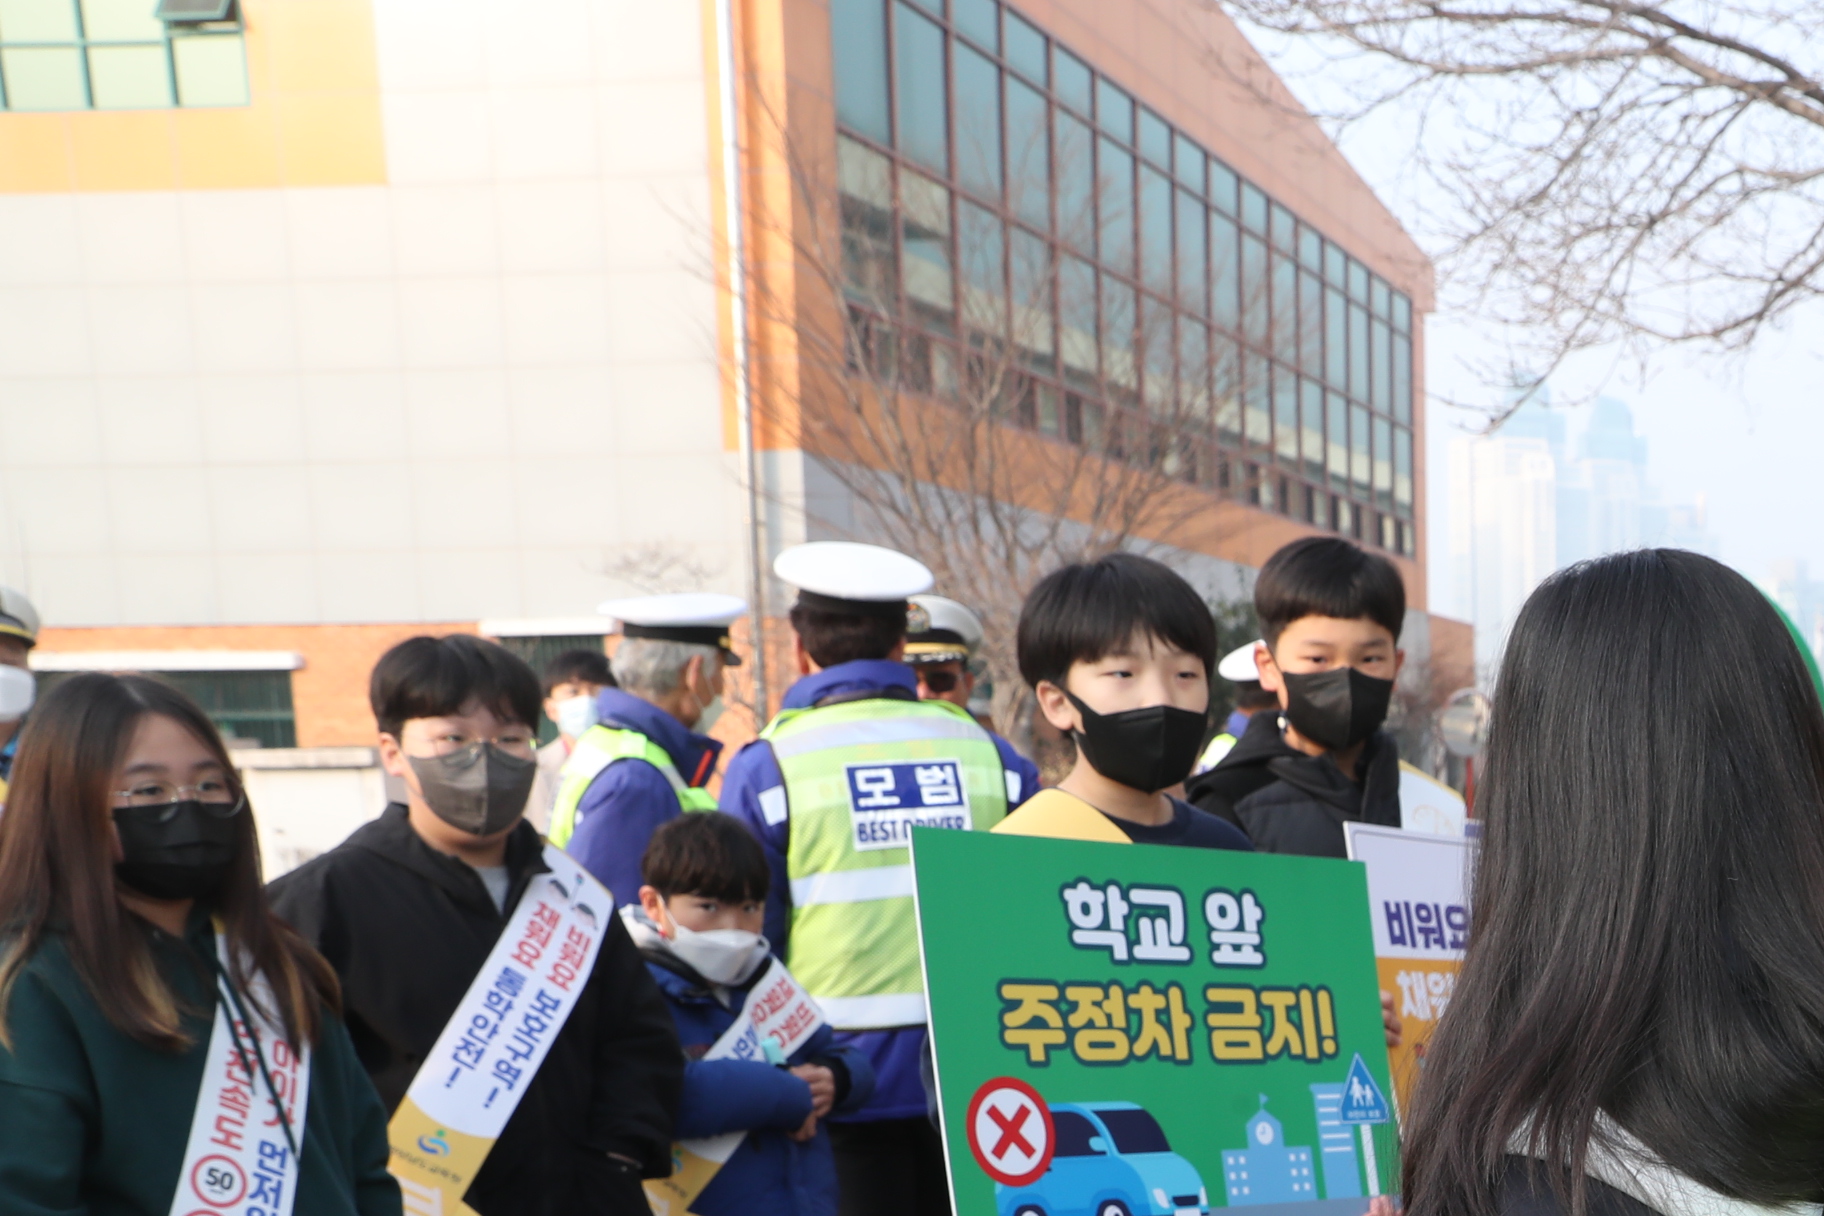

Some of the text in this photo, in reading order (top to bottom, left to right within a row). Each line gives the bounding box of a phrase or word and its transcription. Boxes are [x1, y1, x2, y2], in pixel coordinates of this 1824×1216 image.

[857, 819, 899, 843] BEST
[511, 900, 562, 970] 채워요
[1060, 879, 1265, 967] 학교 앞
[1383, 900, 1469, 949] 비워요
[547, 924, 592, 992] 비워요
[1000, 982, 1337, 1063] 주정차 금지!
[205, 1167, 235, 1192] 50
